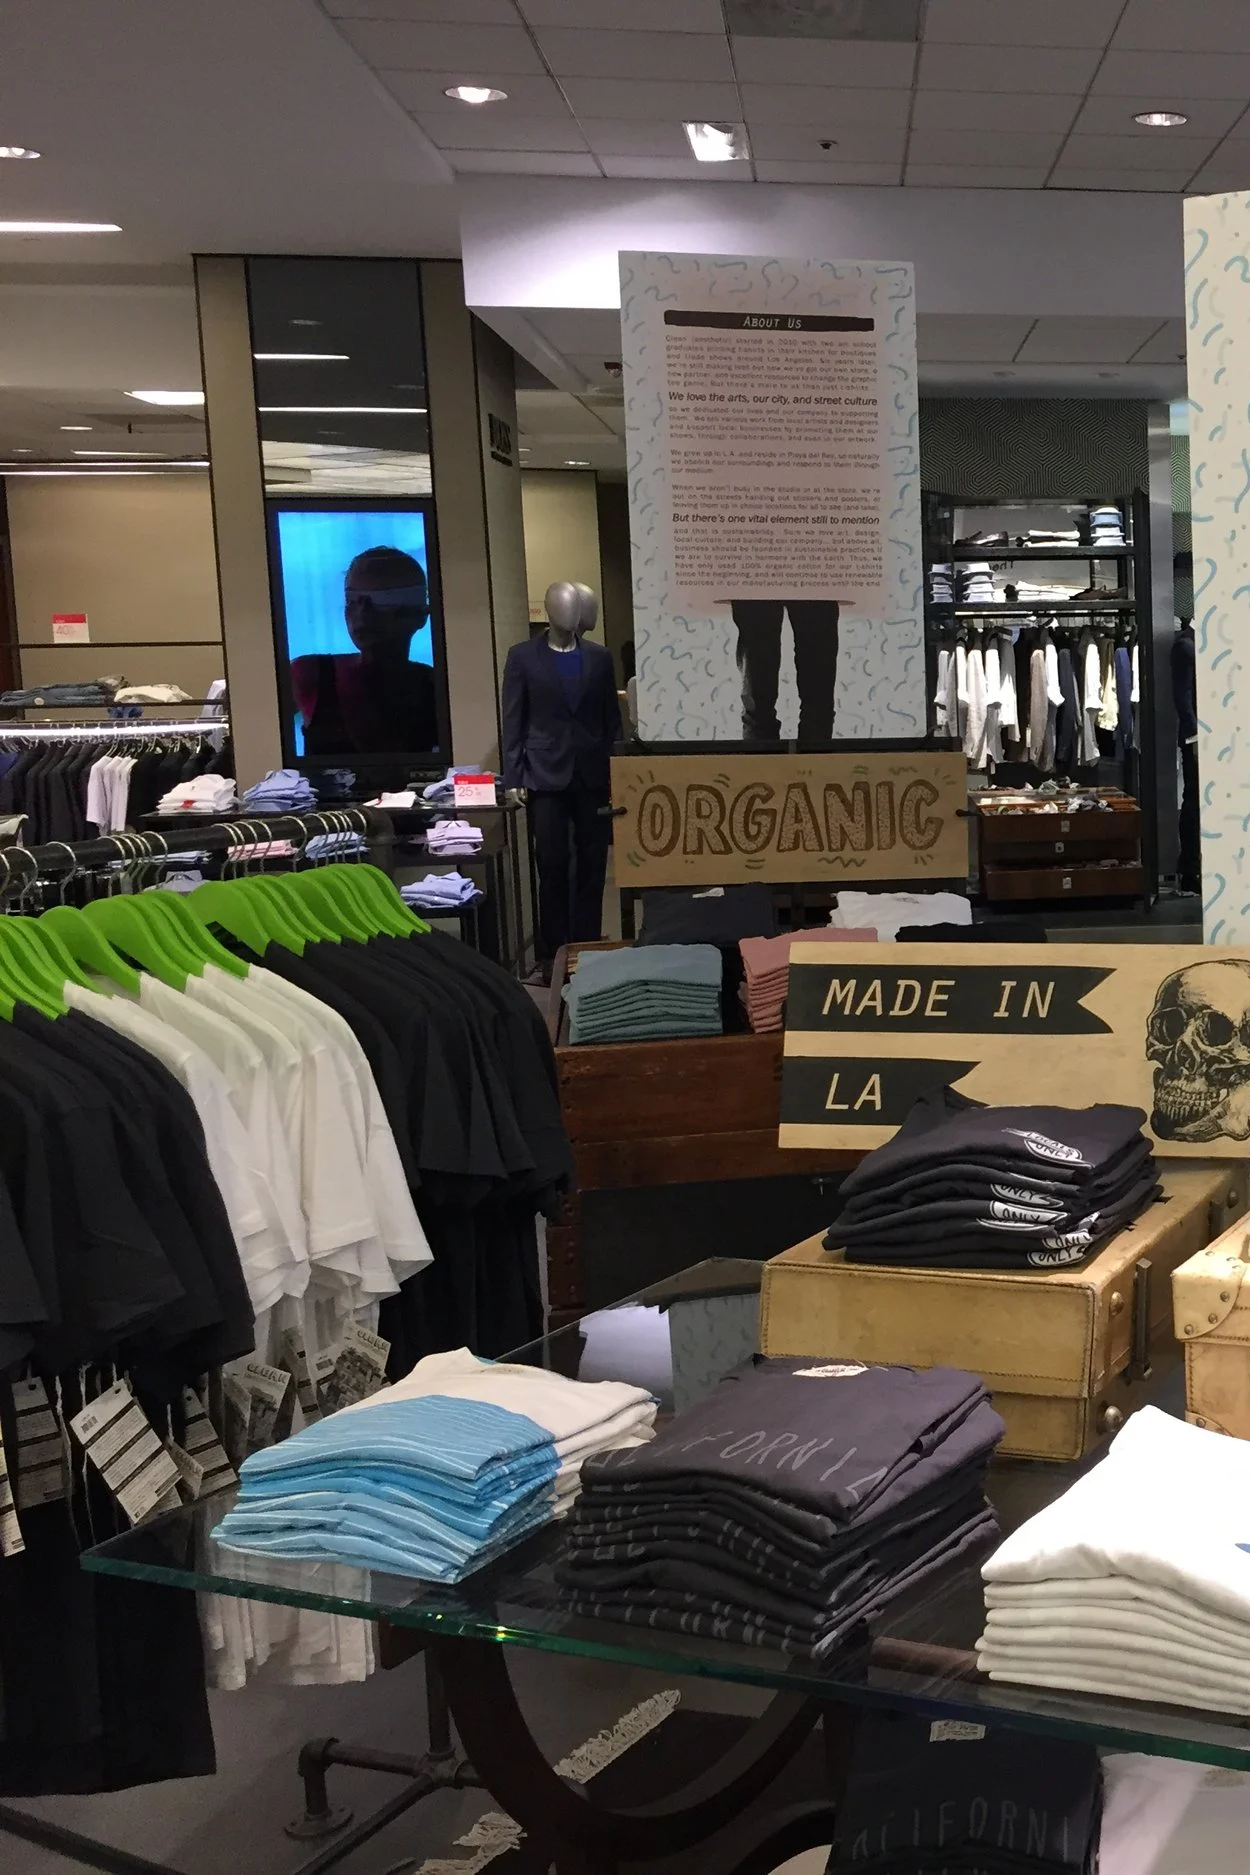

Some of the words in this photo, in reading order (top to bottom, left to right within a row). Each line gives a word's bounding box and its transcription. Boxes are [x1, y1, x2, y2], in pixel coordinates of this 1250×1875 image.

[743, 316, 780, 329] ABOUT
[787, 317, 802, 329] US
[668, 391, 684, 400] We
[686, 391, 705, 400] love
[709, 392, 724, 401] the
[727, 392, 749, 403] arts,
[752, 394, 768, 402] our
[771, 393, 790, 404] city,
[792, 393, 811, 403] and
[814, 394, 842, 403] street
[844, 394, 877, 404] culture
[672, 512, 689, 521] But
[691, 512, 724, 522] there's
[727, 514, 745, 522] one
[748, 513, 767, 522] vital
[770, 513, 809, 522] element
[811, 514, 827, 522] still
[830, 514, 839, 523] to
[841, 514, 879, 523] mention
[637, 779, 944, 857] ORGANIC
[822, 979, 956, 1017] MADE
[993, 980, 1055, 1018] IN
[825, 1073, 882, 1111] LA
[1000, 1184, 1035, 1198] ONLY
[1002, 1208, 1040, 1222] ONLY
[1038, 1246, 1075, 1262] ONLY
